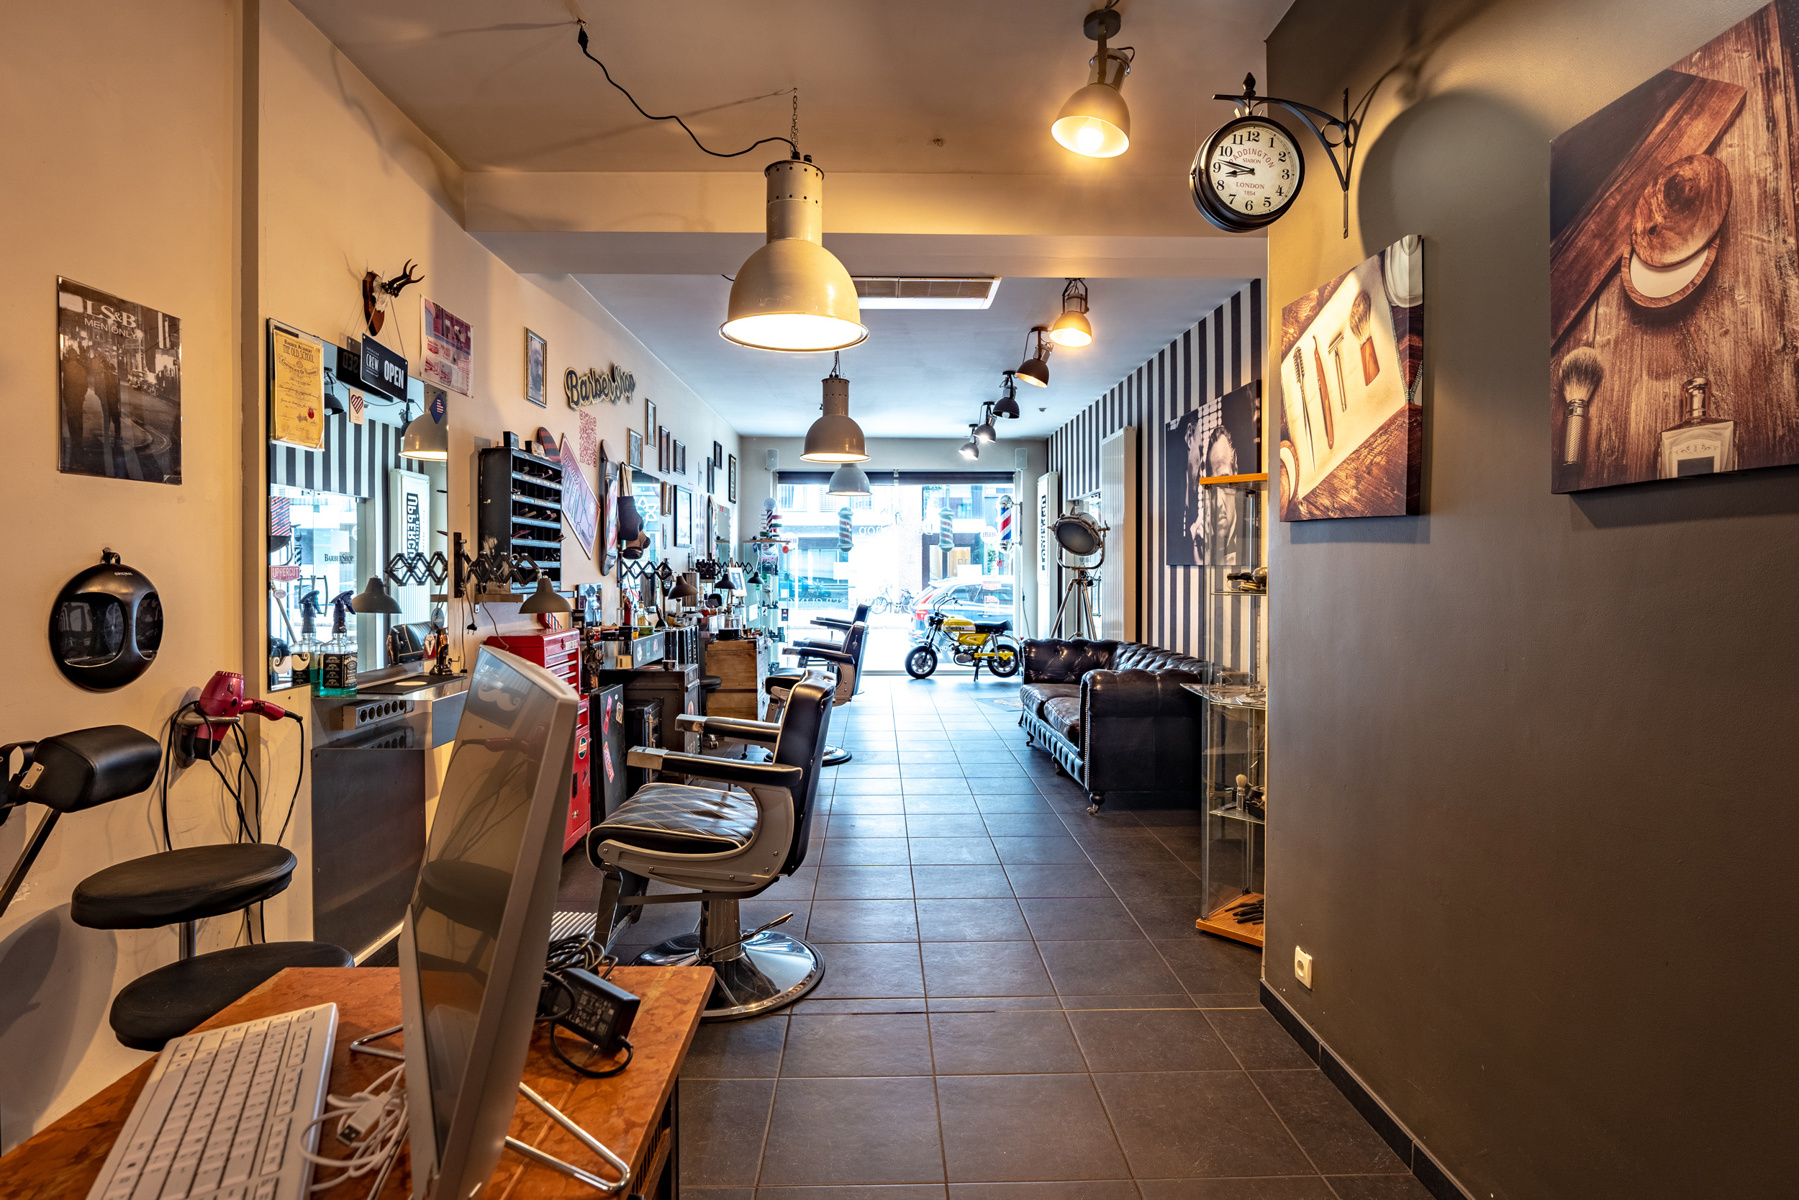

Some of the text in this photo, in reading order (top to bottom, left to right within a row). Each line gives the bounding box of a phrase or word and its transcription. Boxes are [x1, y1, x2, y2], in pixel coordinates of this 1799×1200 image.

[1232, 134, 1244, 146] 11
[1246, 131, 1260, 143] 12
[1268, 137, 1275, 148] 1
[1219, 145, 1233, 157] 10
[1278, 151, 1287, 163] 2
[1228, 147, 1275, 169] PADDINGTON
[1213, 162, 1221, 173] 9
[1281, 168, 1290, 180] 3
[1216, 179, 1225, 191] 8
[1235, 181, 1265, 190] LONDON
[1275, 185, 1284, 196] 4
[1228, 194, 1237, 205] 7
[1245, 200, 1254, 211] 6
[1263, 197, 1272, 208] 5
[85, 299, 137, 328] LS&B
[84, 318, 138, 339] MEN ONLY
[383, 360, 405, 389] OPEN
